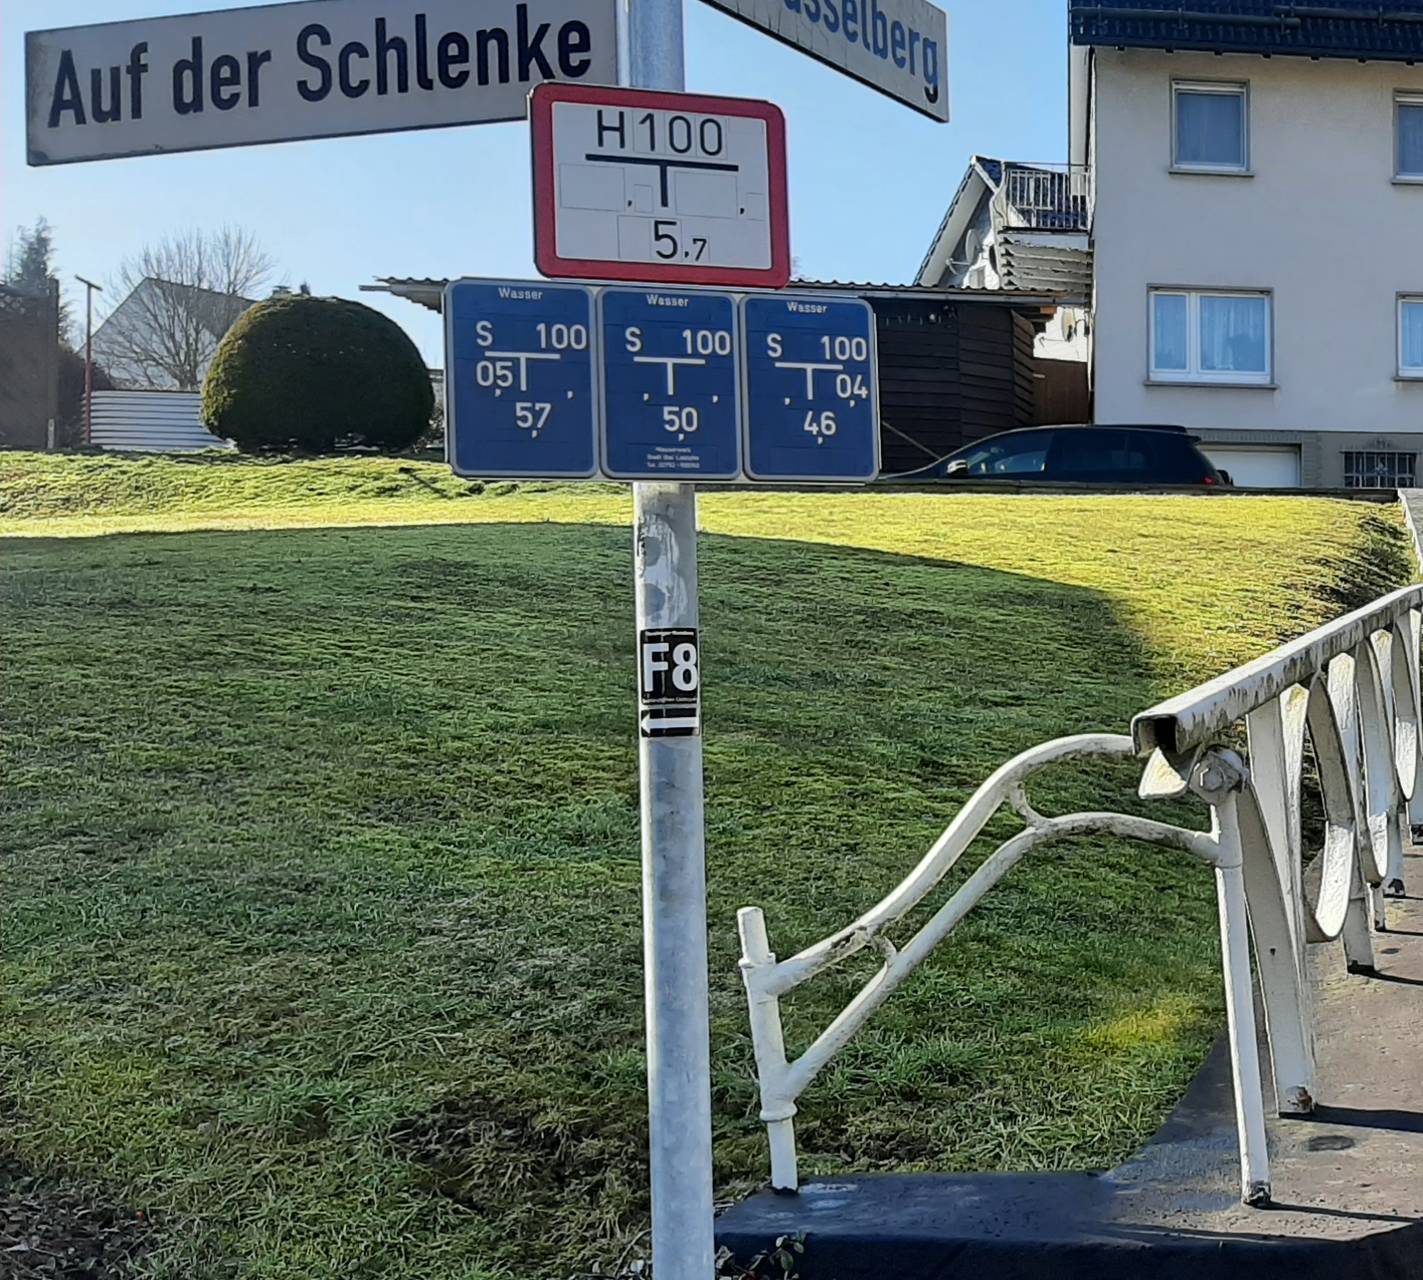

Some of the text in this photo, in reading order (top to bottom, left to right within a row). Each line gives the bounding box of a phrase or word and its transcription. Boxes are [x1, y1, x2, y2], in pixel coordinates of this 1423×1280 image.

[48, 3, 592, 128] Auf der Schlenke
[784, 0, 939, 104] sselberg
[498, 287, 543, 300] Wasser
[646, 294, 689, 308] Wasser
[786, 301, 828, 314] Wasser
[475, 320, 587, 350] S 100
[625, 327, 731, 356] S 100
[766, 333, 867, 361] S 100
[643, 642, 698, 692] F8
